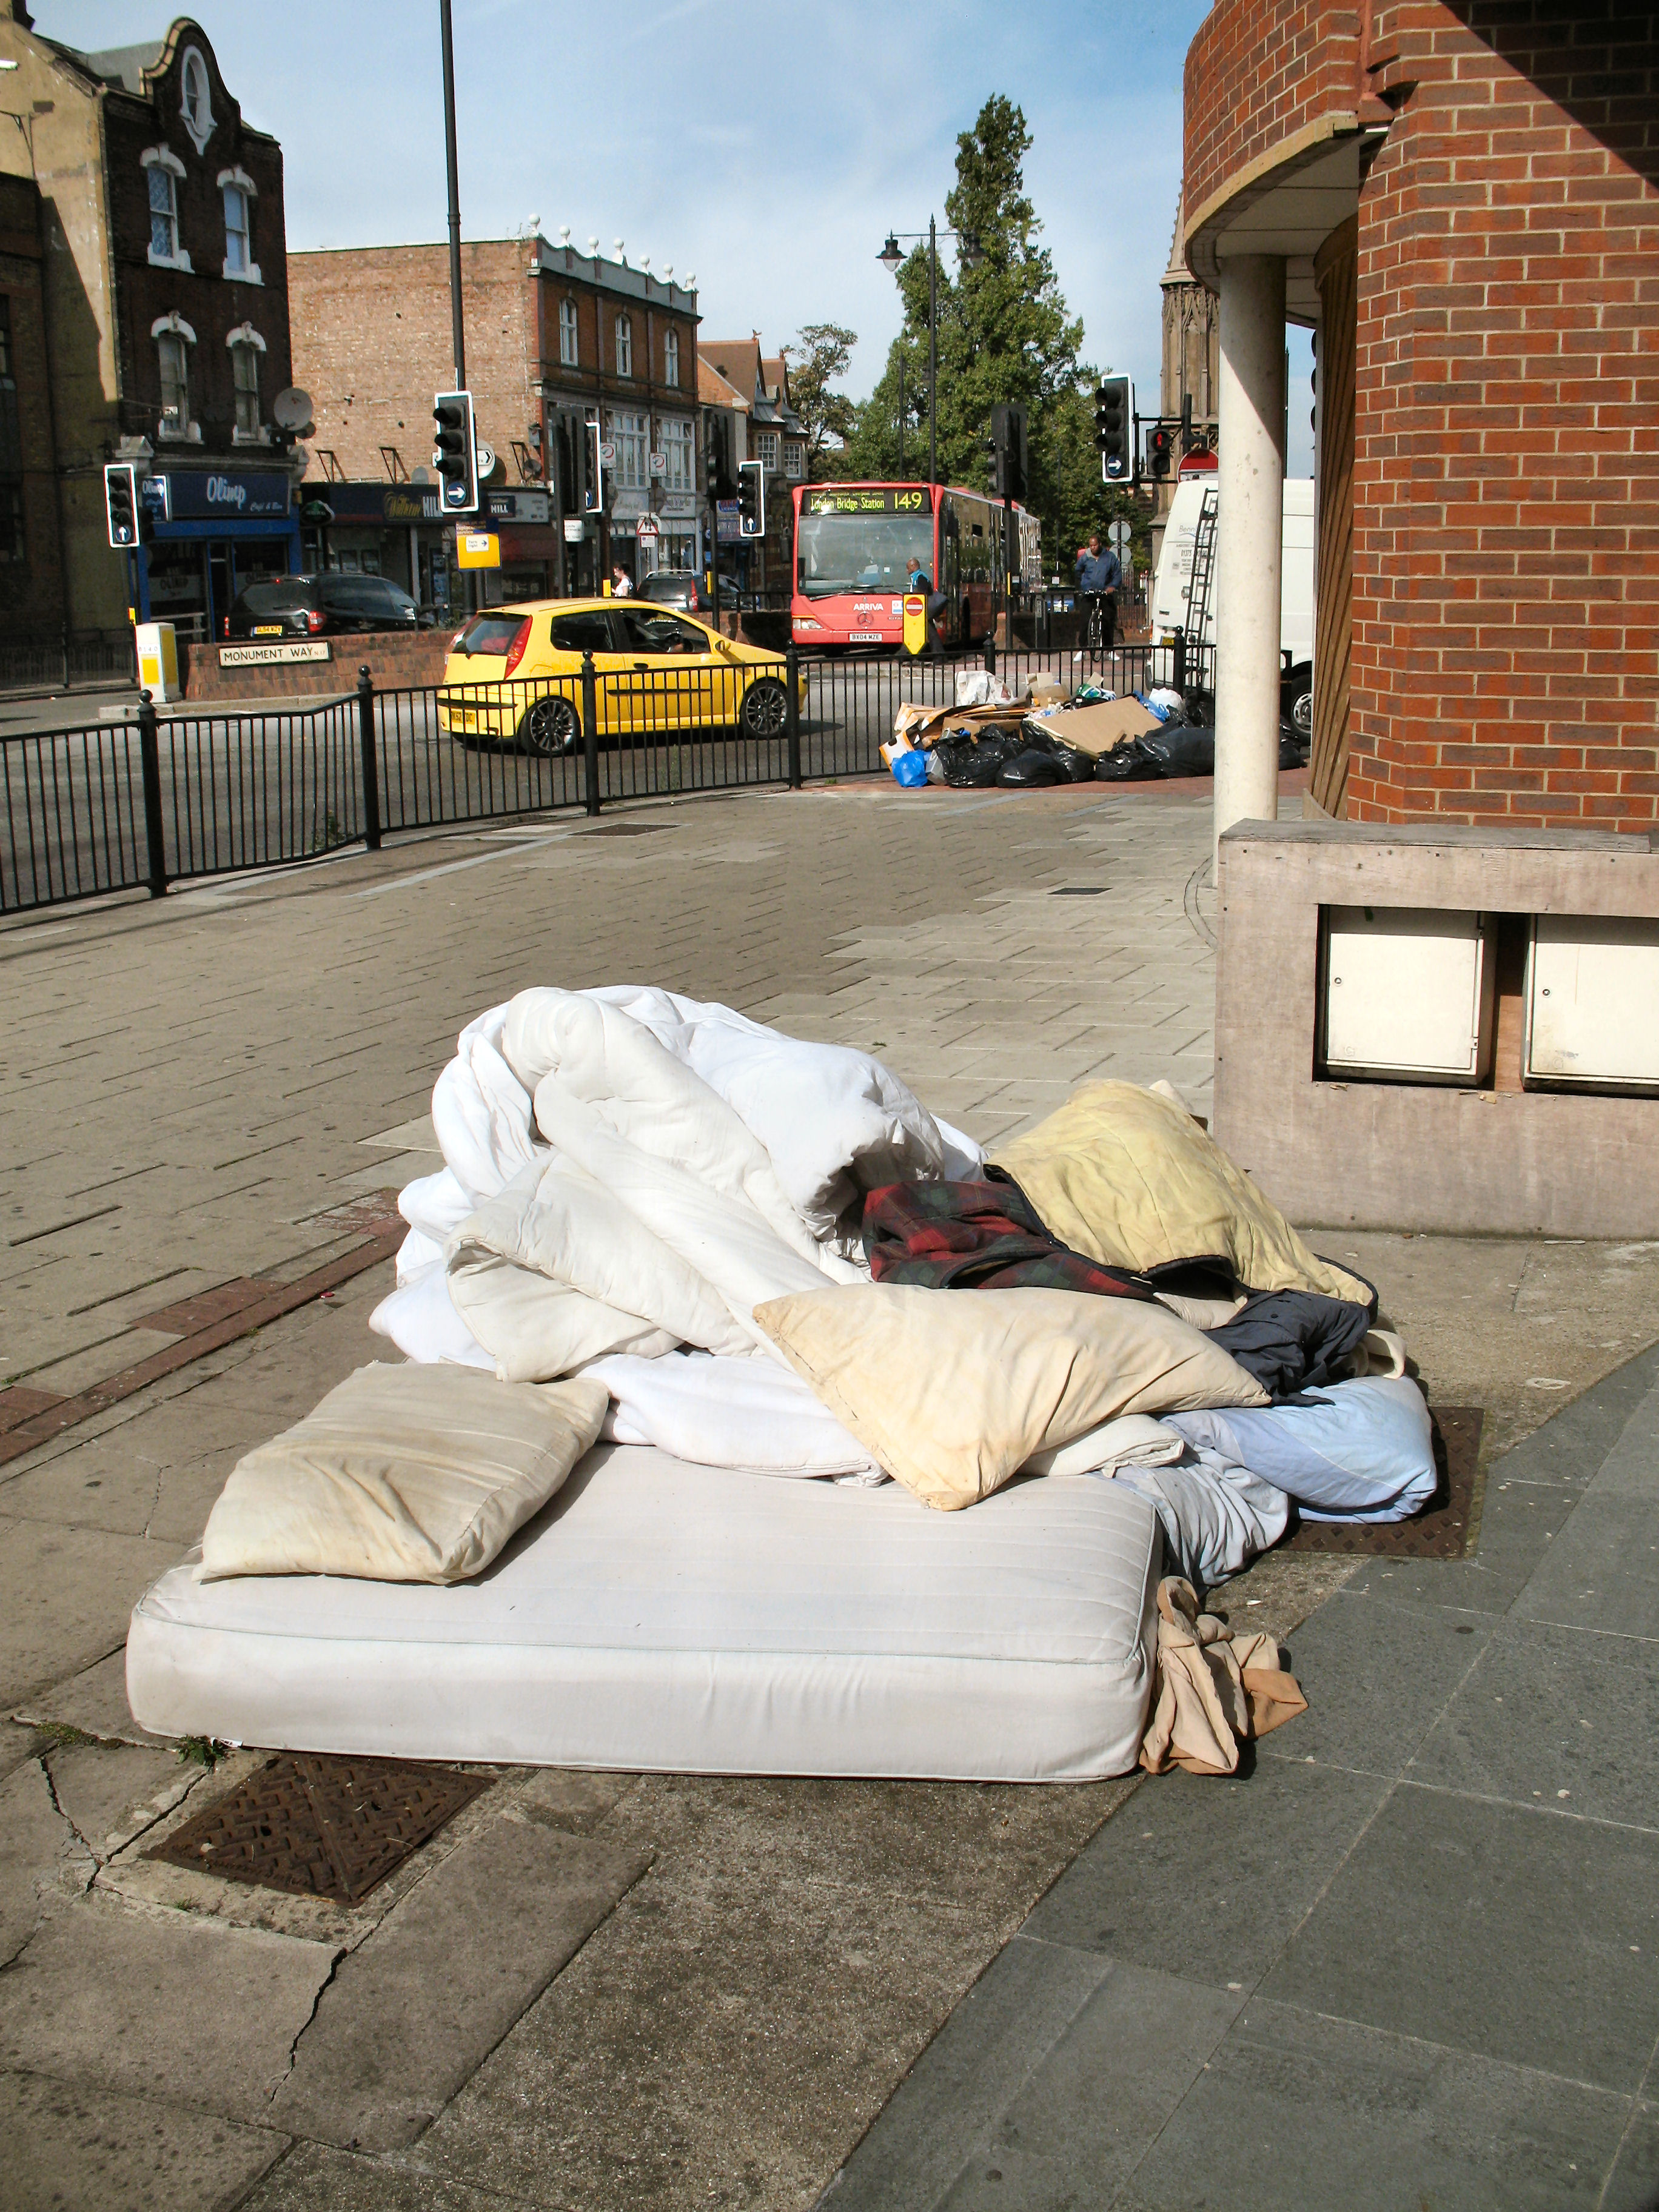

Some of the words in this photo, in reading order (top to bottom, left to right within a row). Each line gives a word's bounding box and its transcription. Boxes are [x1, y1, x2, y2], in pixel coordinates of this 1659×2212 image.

[207, 476, 246, 511] Olimp
[894, 492, 922, 509] 149
[491, 504, 508, 513] HILL
[837, 497, 858, 512] Bridge
[860, 497, 885, 511] Station
[224, 649, 283, 662] MONUMENT
[290, 647, 313, 657] WAY
